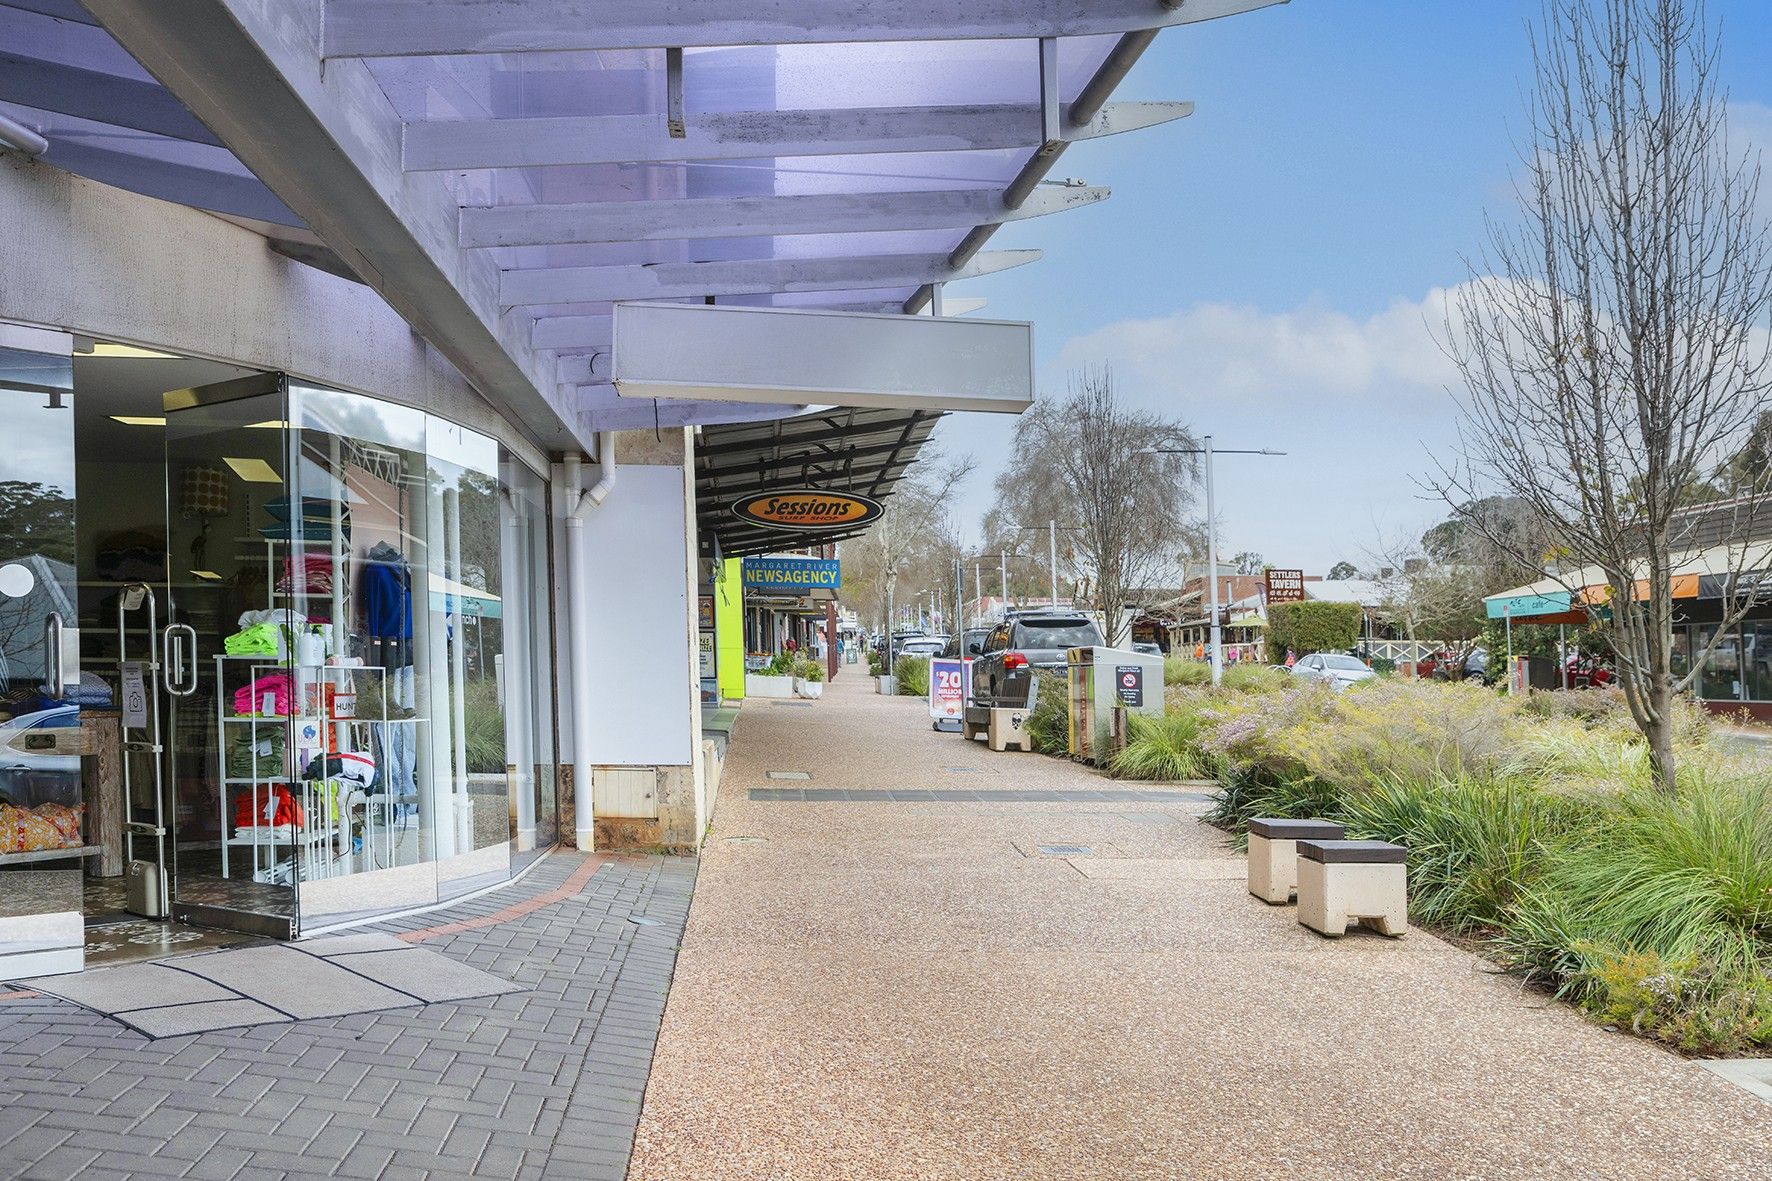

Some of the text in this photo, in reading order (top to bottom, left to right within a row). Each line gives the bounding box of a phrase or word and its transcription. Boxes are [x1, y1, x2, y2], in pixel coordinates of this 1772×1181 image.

[764, 498, 851, 515] Sessions
[746, 562, 838, 571] MARGARET RIVER
[746, 569, 837, 584] NEWSAGENCY
[1269, 571, 1301, 579] SETTLERS
[1269, 579, 1301, 589] TAVERN
